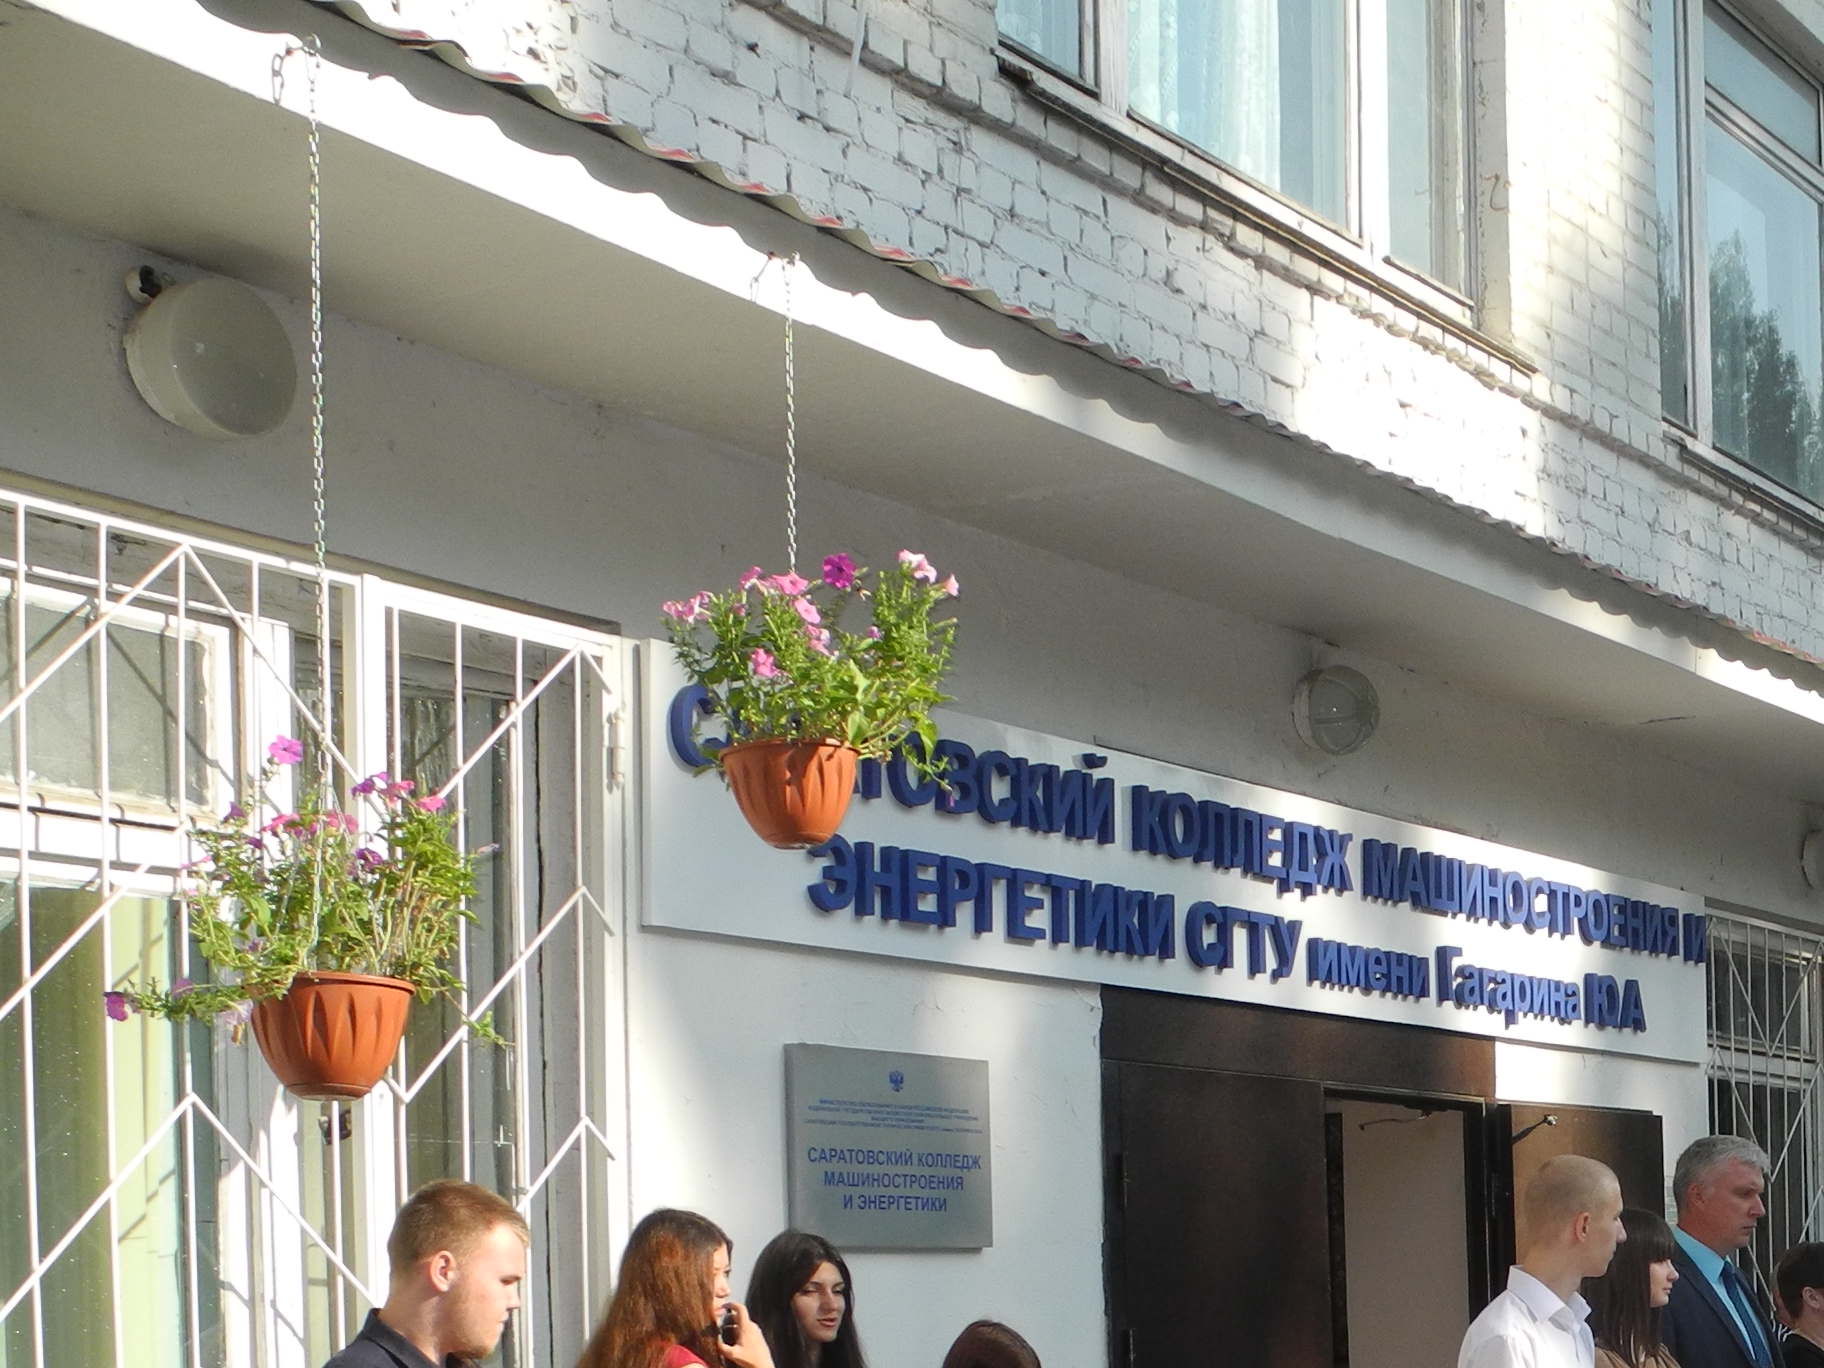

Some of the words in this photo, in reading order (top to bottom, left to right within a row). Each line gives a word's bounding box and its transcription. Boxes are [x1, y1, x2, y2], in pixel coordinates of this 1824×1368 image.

[1132, 784, 1353, 897] КОЛЛЕДЖ
[1363, 838, 1680, 957] МАШИНОСТРОЕНИЯ
[1683, 912, 1706, 964] И
[807, 834, 1175, 960] ЭНЕРГЕТИКИ
[1185, 901, 1302, 981] СГТУ
[1306, 937, 1430, 1000] имени
[1435, 946, 1582, 1027] Гагарина
[1583, 972, 1648, 1032] ЮА
[807, 1146, 914, 1167] САРАТОВСКИЙ
[917, 1152, 982, 1173] КОЛЛЕДЖ
[823, 1170, 965, 1191] МАШИНОСТРОЕНИЯ
[843, 1194, 853, 1210] И
[857, 1194, 948, 1212] ЭНЕРГЕТИКИ
